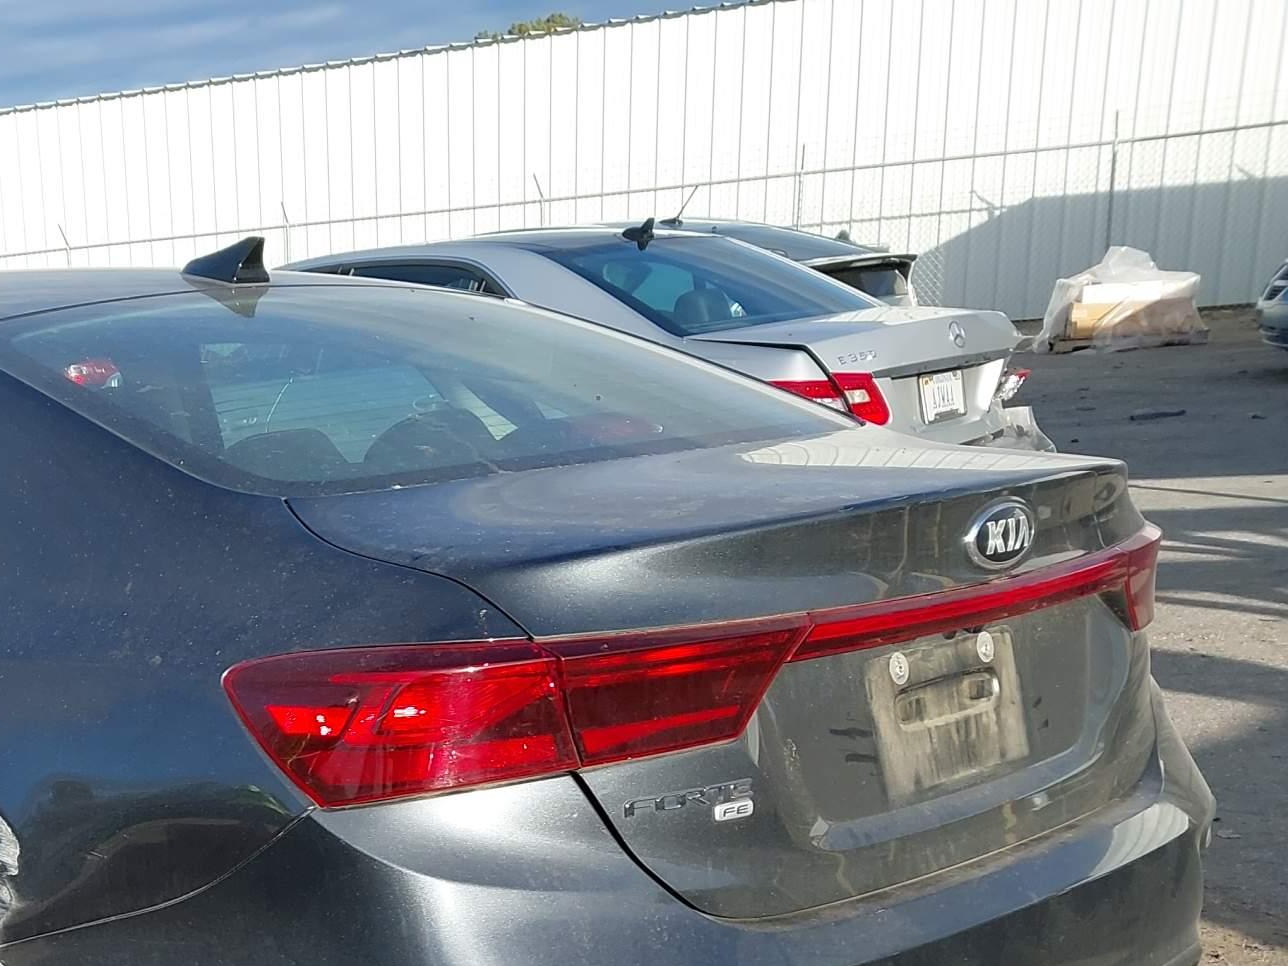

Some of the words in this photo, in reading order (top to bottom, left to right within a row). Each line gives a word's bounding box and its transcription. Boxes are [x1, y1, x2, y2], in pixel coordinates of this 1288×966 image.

[986, 515, 1029, 555] KIA
[623, 777, 753, 818] FORTE
[723, 803, 750, 818] FE
